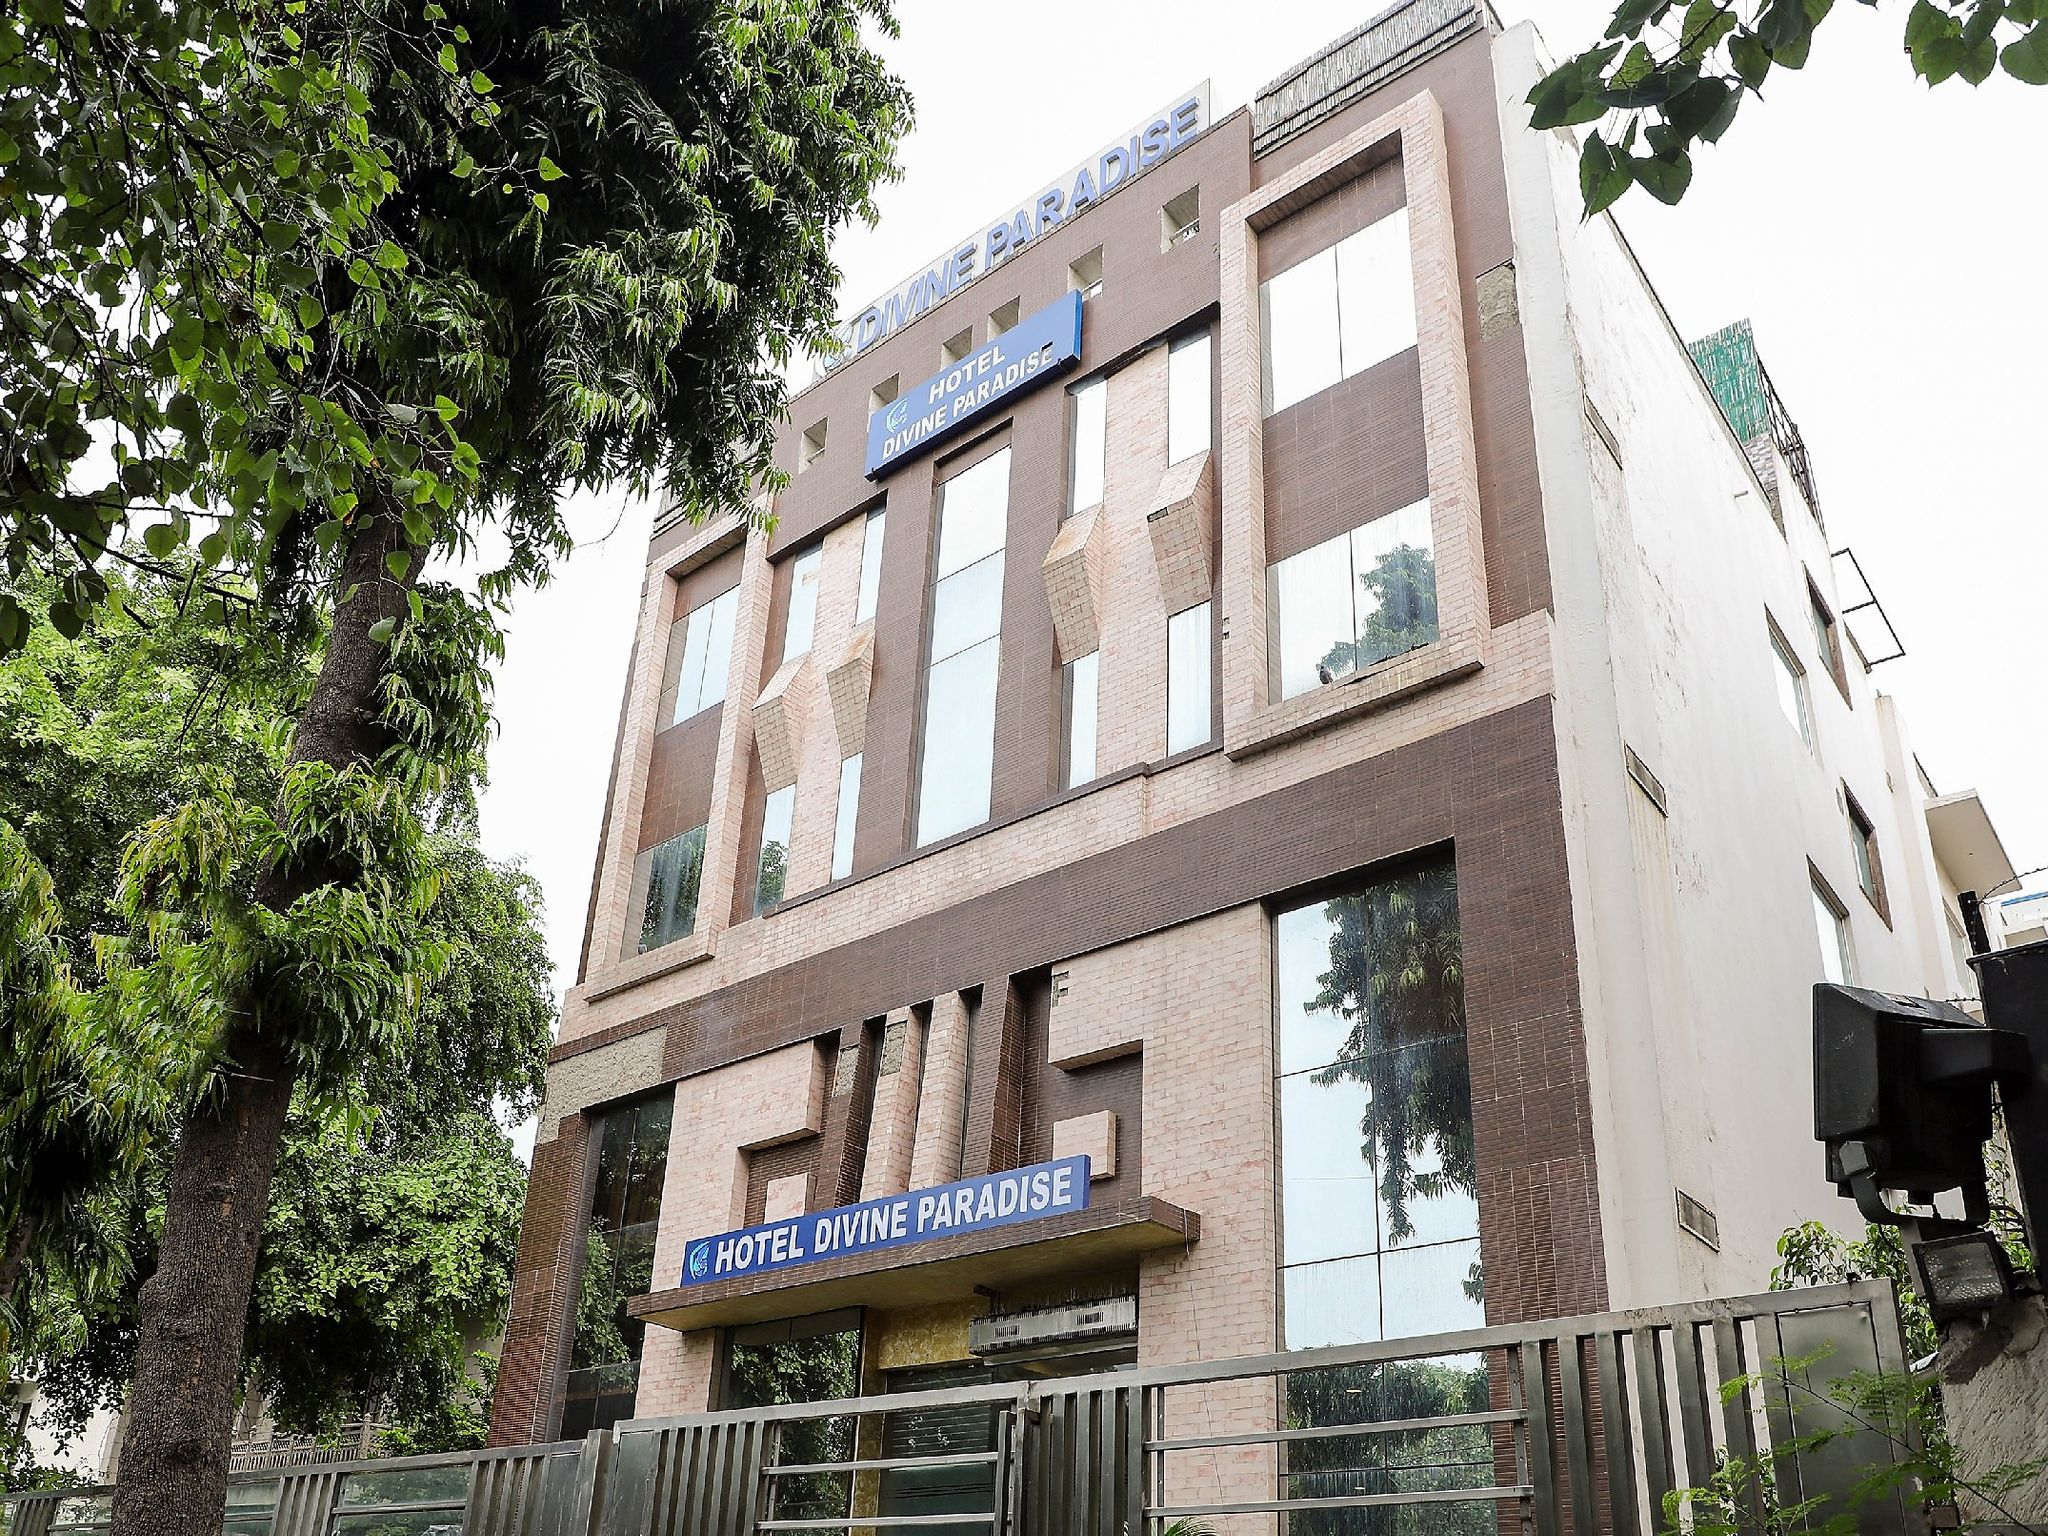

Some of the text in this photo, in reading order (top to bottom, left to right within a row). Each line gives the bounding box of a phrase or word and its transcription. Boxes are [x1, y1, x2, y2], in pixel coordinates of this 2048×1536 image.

[857, 96, 1200, 354] DIVINE PARADISE
[881, 342, 1054, 460] DIVINE PARADISE
[929, 345, 1005, 404] HOTEL
[715, 1166, 1073, 1274] HOTEL DIVINE PARADISE
